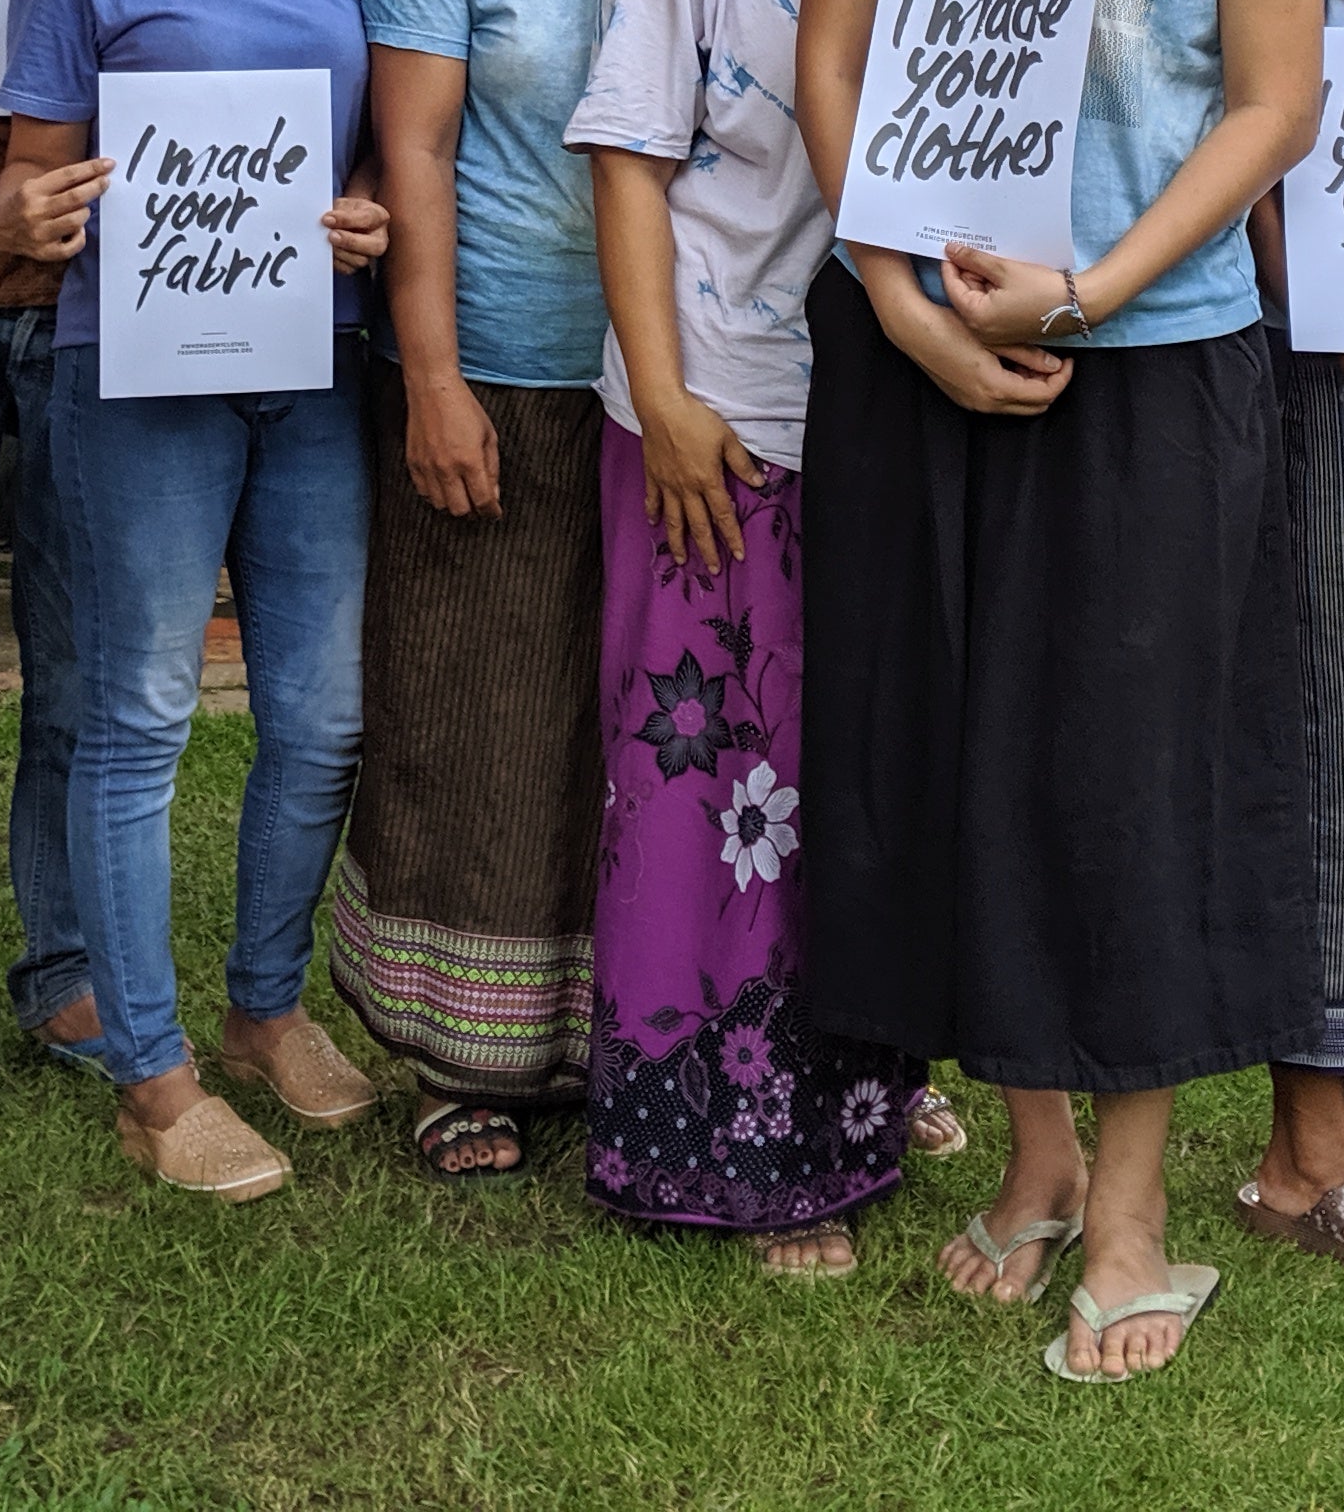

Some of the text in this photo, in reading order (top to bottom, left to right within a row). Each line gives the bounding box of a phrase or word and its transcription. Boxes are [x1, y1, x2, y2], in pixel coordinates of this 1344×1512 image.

[891, 46, 1043, 119] your
[126, 116, 308, 187] I made
[866, 104, 1063, 182] clothes
[138, 187, 259, 250] your
[136, 232, 298, 311] fabric
